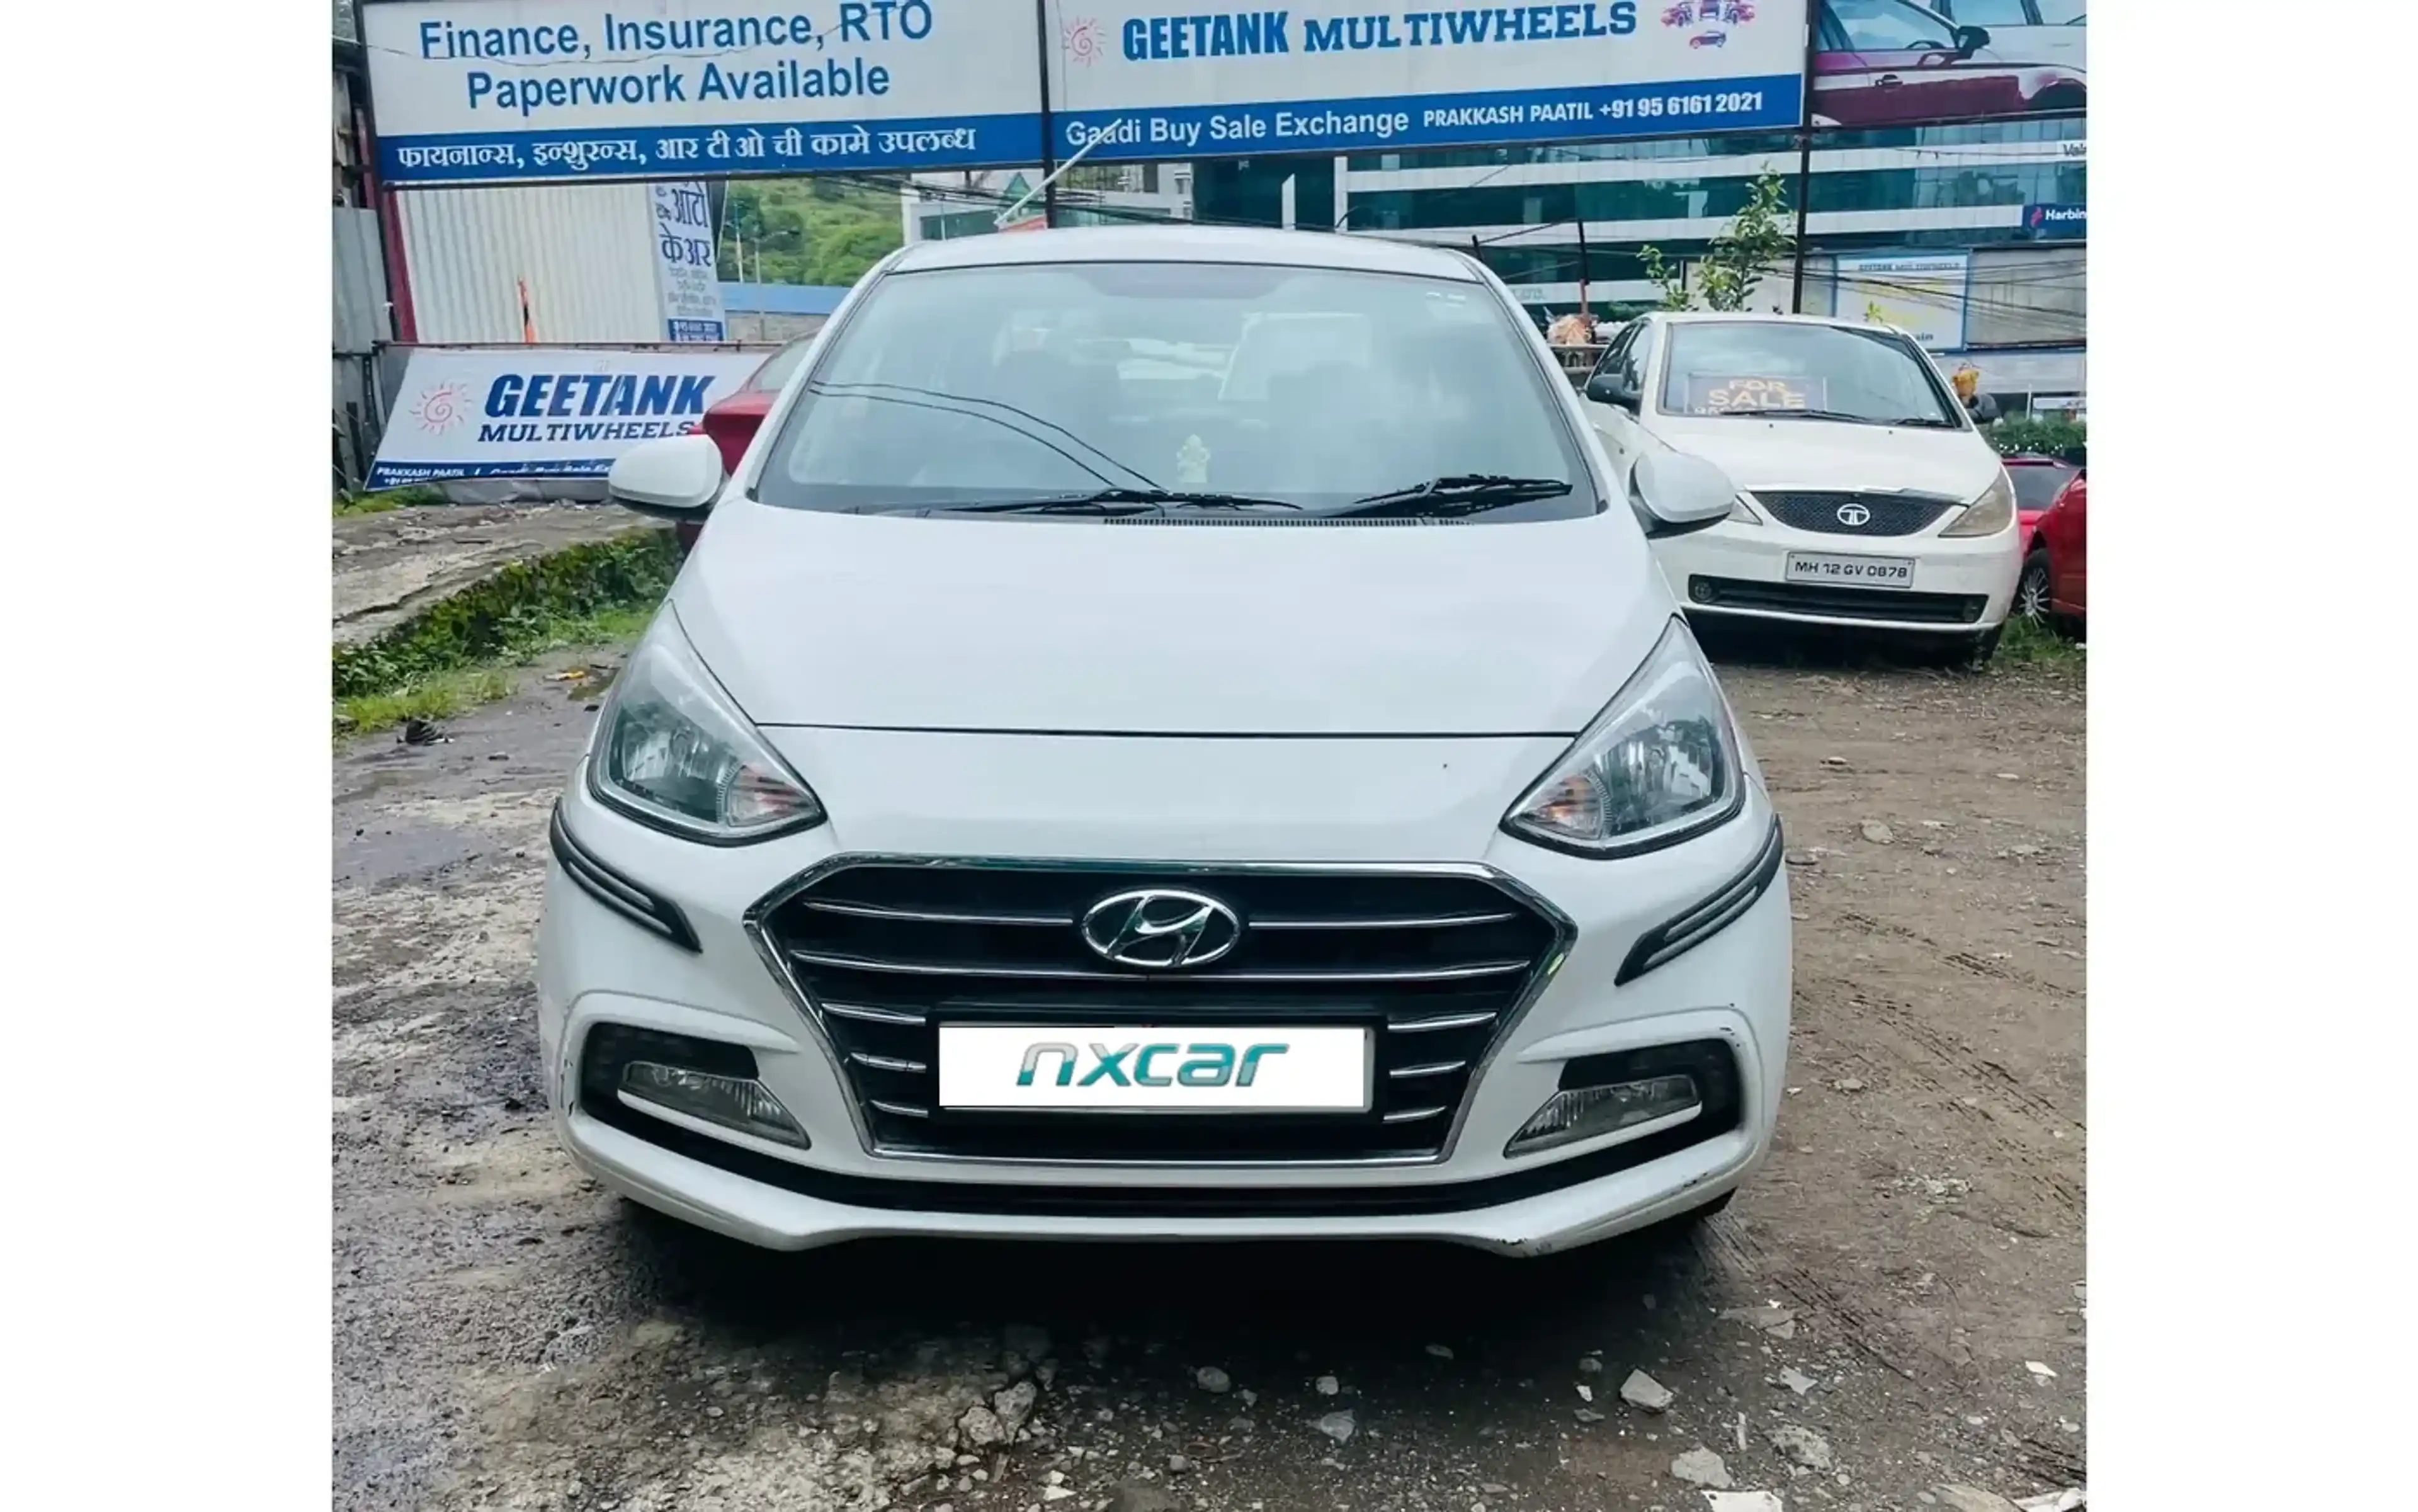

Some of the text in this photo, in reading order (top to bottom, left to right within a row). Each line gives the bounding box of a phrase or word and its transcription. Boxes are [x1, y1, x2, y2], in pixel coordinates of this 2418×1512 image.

[420, 0, 933, 60] Finance, Insurance, RTO
[1122, 1, 1637, 61] GEETANK MULTIWHEELS
[467, 57, 890, 117] Paperwork Available
[1423, 91, 1763, 127] PRAKKASH PAATIL +91 95 6161 2021
[397, 143, 525, 169] फायनान्स,
[656, 138, 699, 160] आर
[772, 128, 803, 156] ची
[810, 125, 870, 156] कामे
[878, 127, 977, 154] उपलब्ध
[1065, 110, 1409, 147] Gaadi Buy Sale Exchange
[484, 373, 717, 418] GEETANK
[1709, 389, 1805, 409] SALE
[1728, 379, 1791, 393] FOR
[477, 421, 695, 443] MULTIWHEELS
[1795, 562, 1819, 573] MH
[1823, 563, 1841, 575] 12
[1844, 564, 1863, 576] GV
